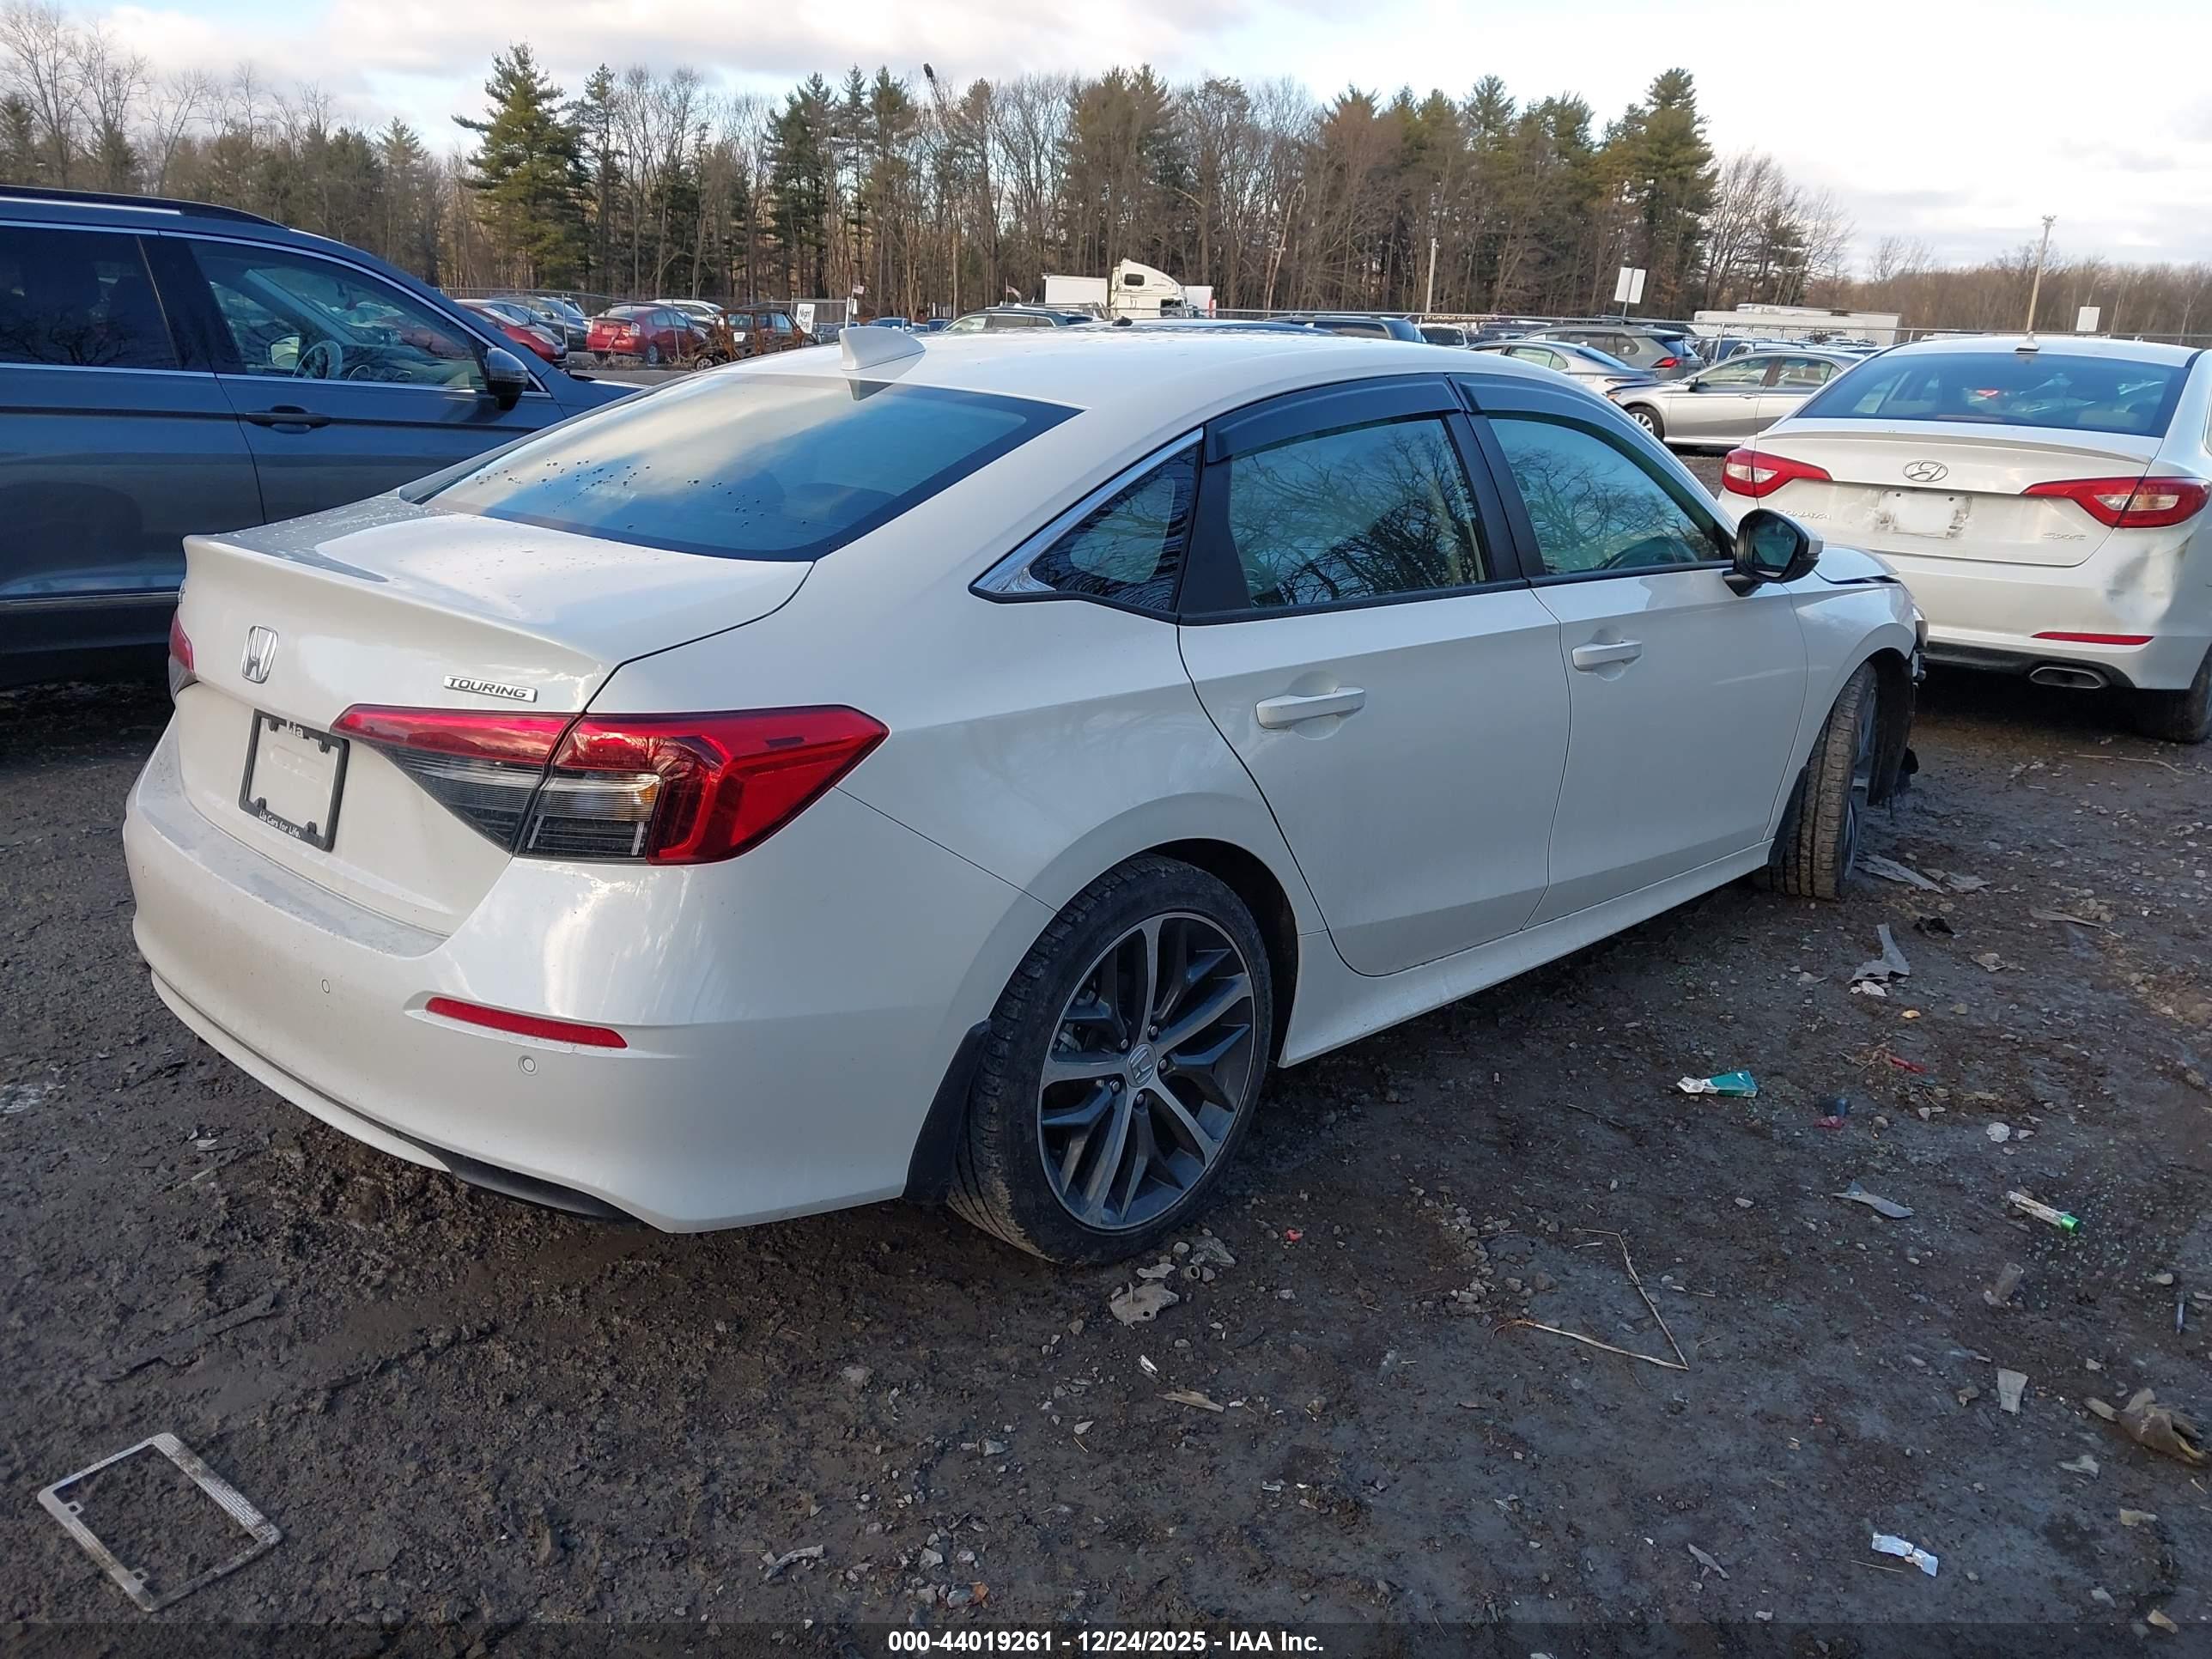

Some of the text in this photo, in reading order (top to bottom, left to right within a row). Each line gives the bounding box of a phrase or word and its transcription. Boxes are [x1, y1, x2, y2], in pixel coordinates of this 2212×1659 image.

[799, 309, 811, 319] Night
[799, 319, 810, 331] Drop
[448, 678, 528, 698] TOURING
[266, 815, 278, 828] Cars
[279, 821, 289, 832] for
